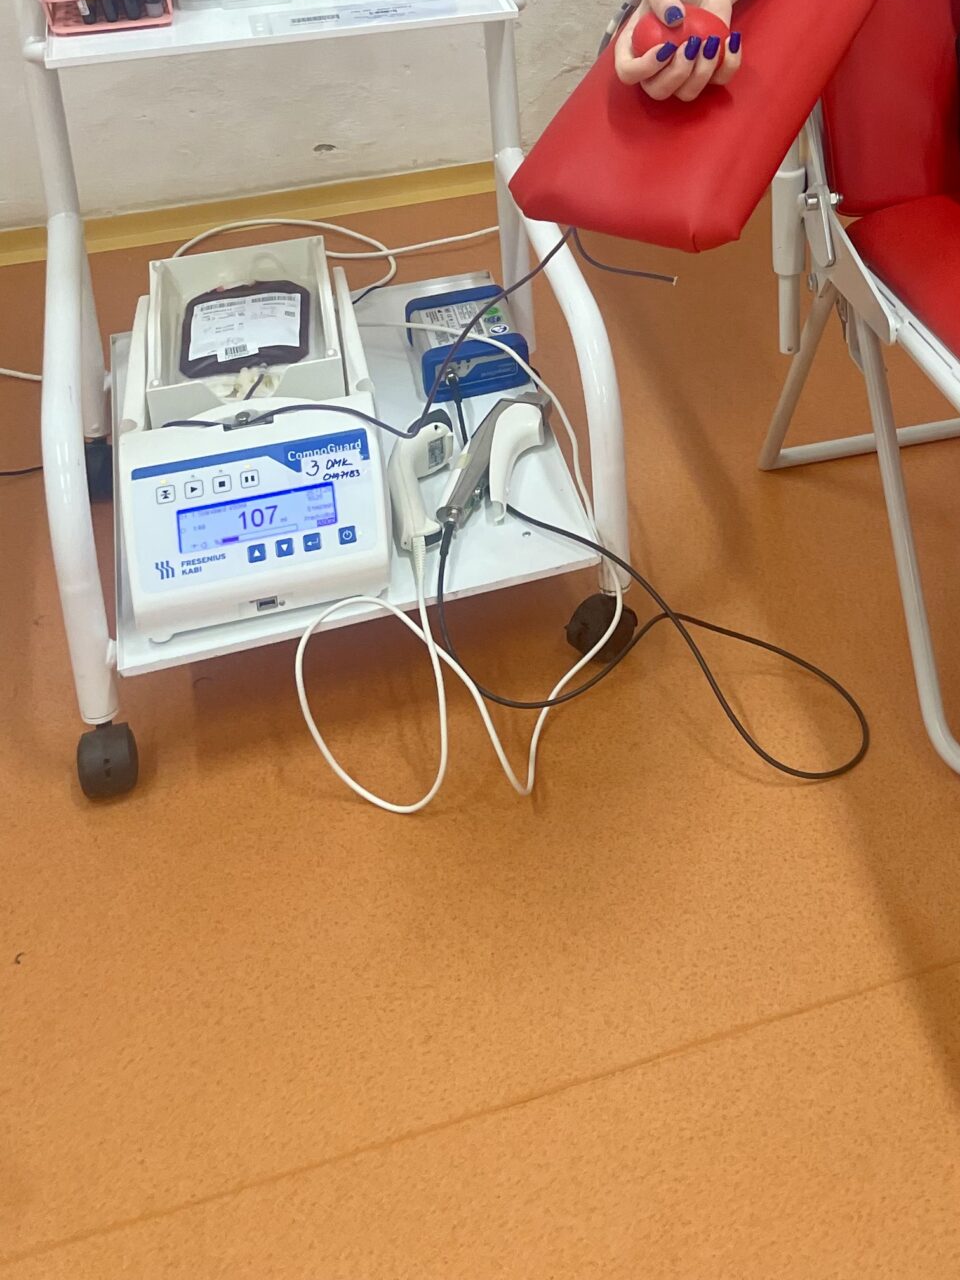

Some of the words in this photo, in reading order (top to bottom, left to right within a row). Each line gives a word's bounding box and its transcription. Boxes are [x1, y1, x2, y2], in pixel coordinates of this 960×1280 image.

[287, 439, 362, 461] CompoGuard
[238, 505, 279, 530] 107
[181, 552, 226, 568] FRESENIUS
[181, 566, 202, 576] KABI
